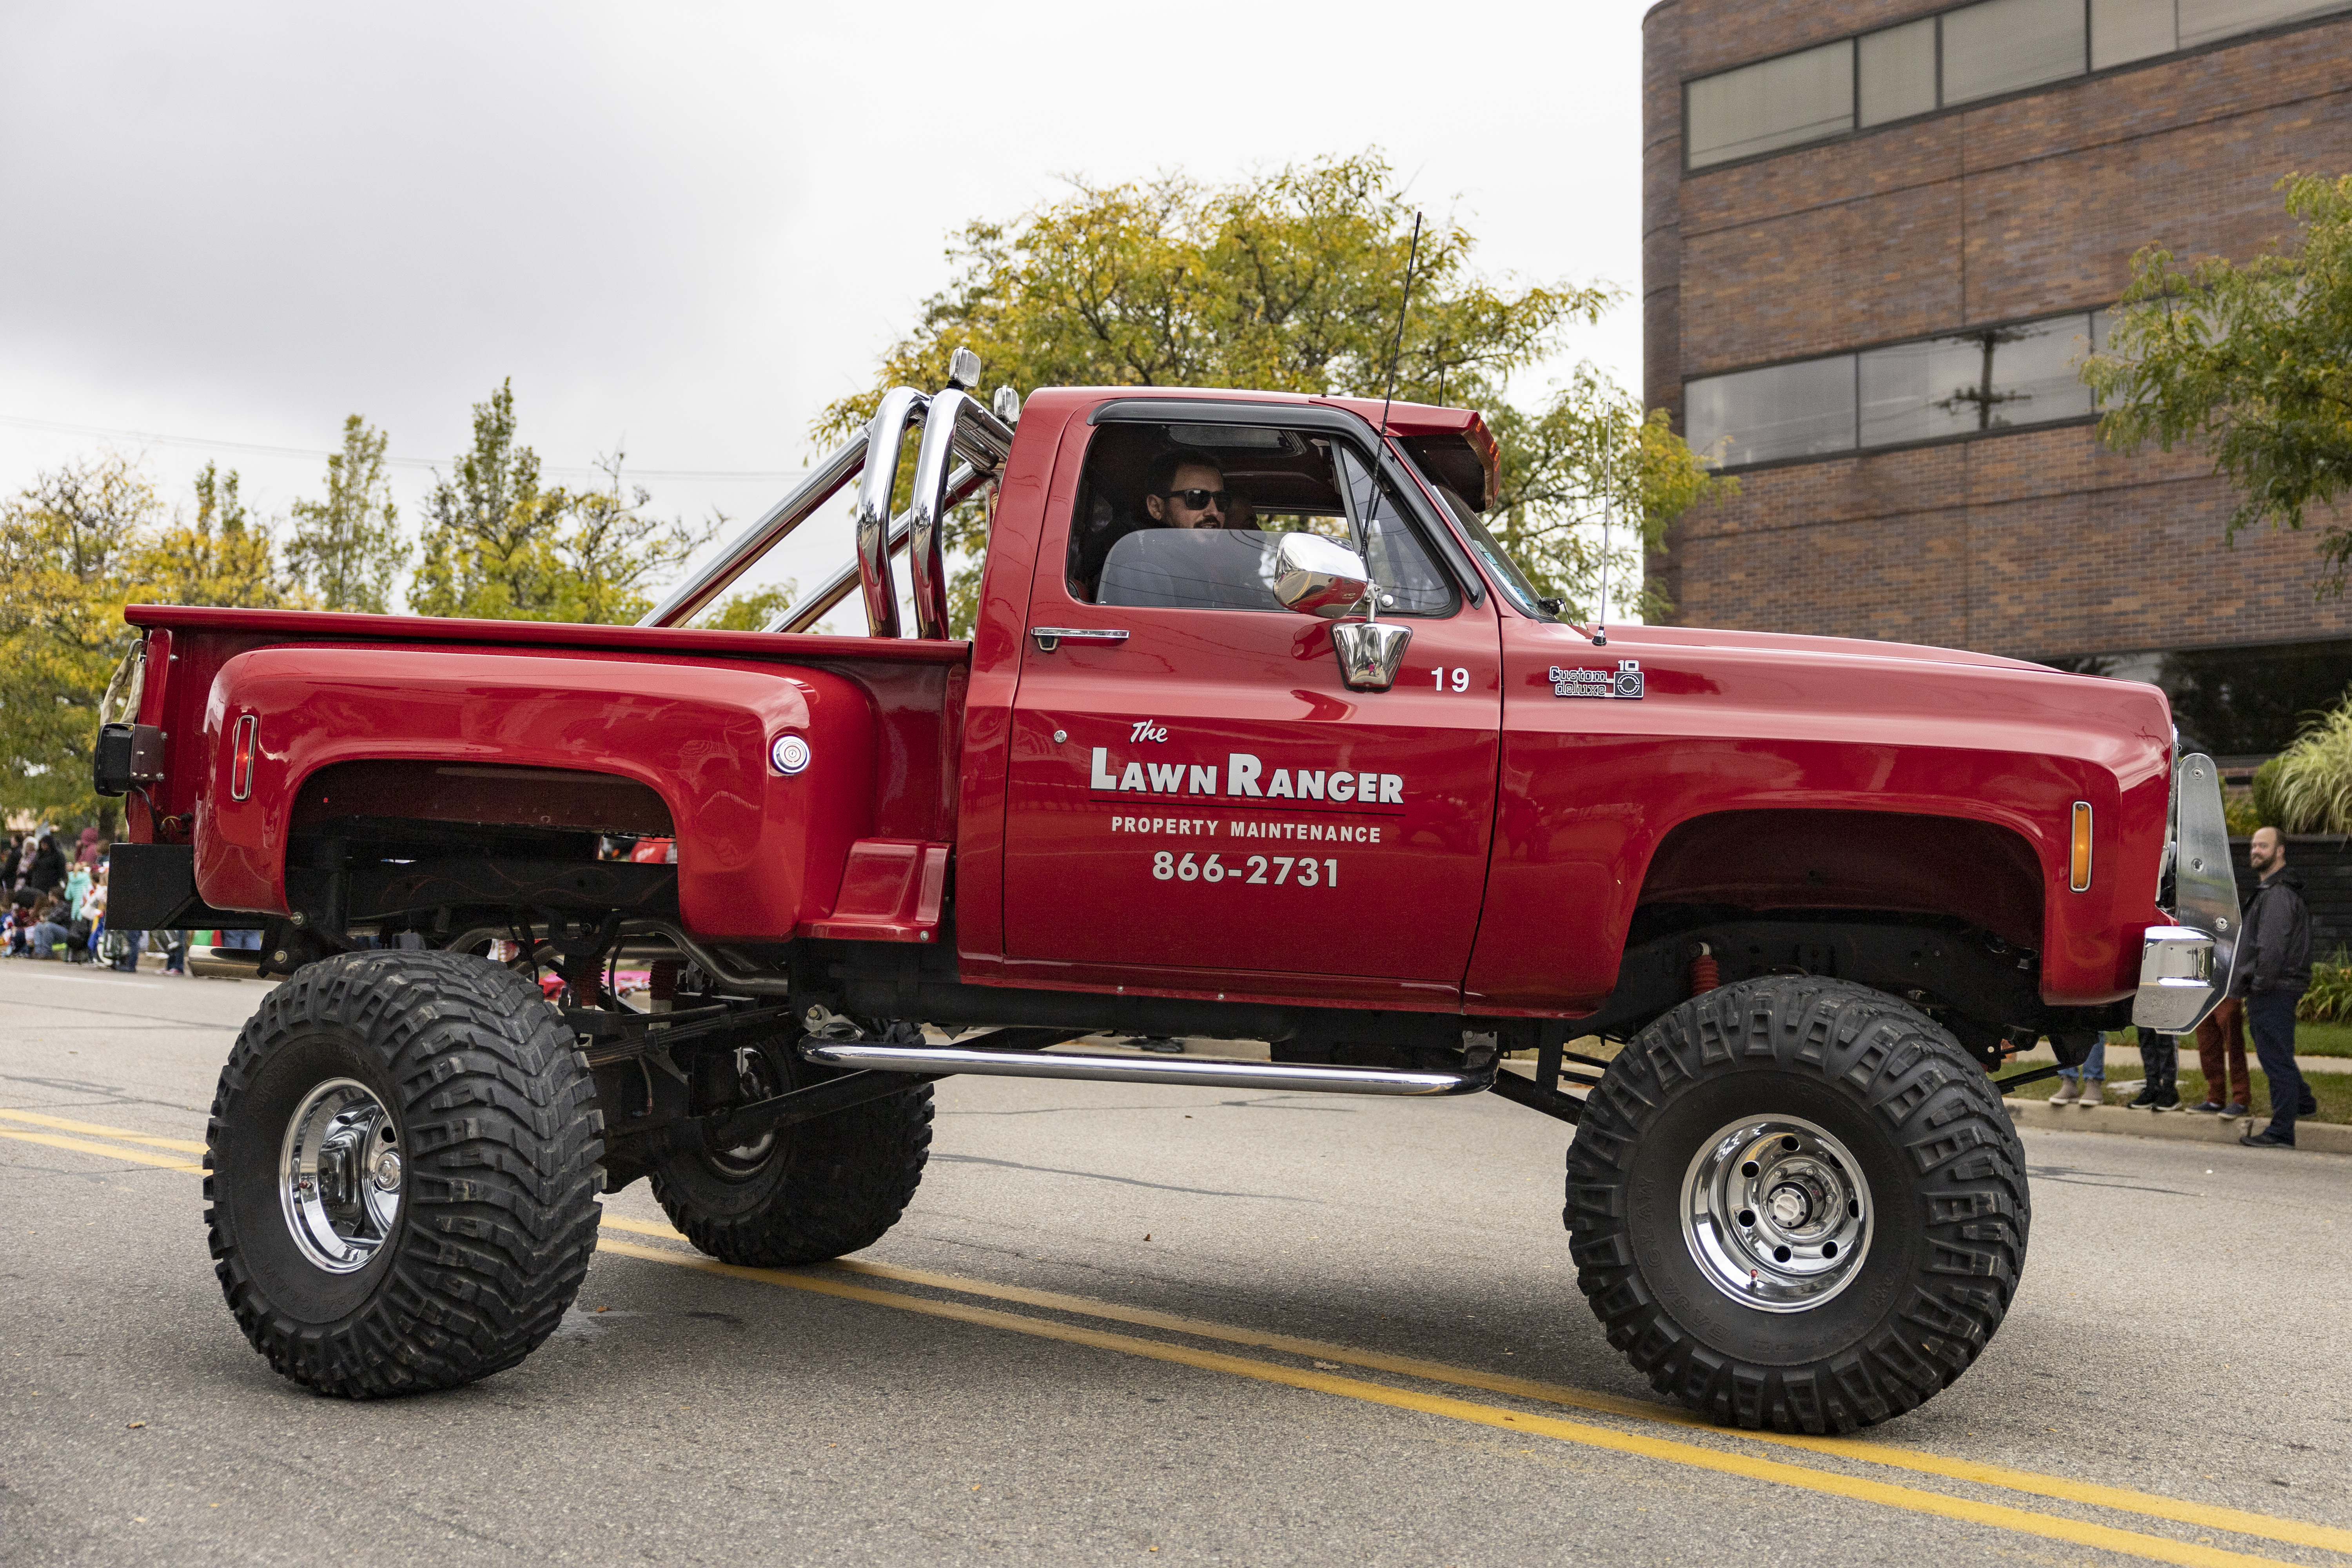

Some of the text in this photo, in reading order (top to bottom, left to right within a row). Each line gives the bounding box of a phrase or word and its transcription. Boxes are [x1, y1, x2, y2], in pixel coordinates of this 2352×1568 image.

[1549, 666, 1607, 683] Custom
[1618, 660, 1639, 671] 10
[1431, 667, 1469, 692] 19
[1555, 681, 1606, 697] deluxe
[1130, 719, 1168, 743] The
[1091, 747, 1404, 804] LAWN RANGER
[1112, 816, 1381, 843] PROPERTY MAINTENANCE
[1152, 851, 1337, 887] 866-2731
